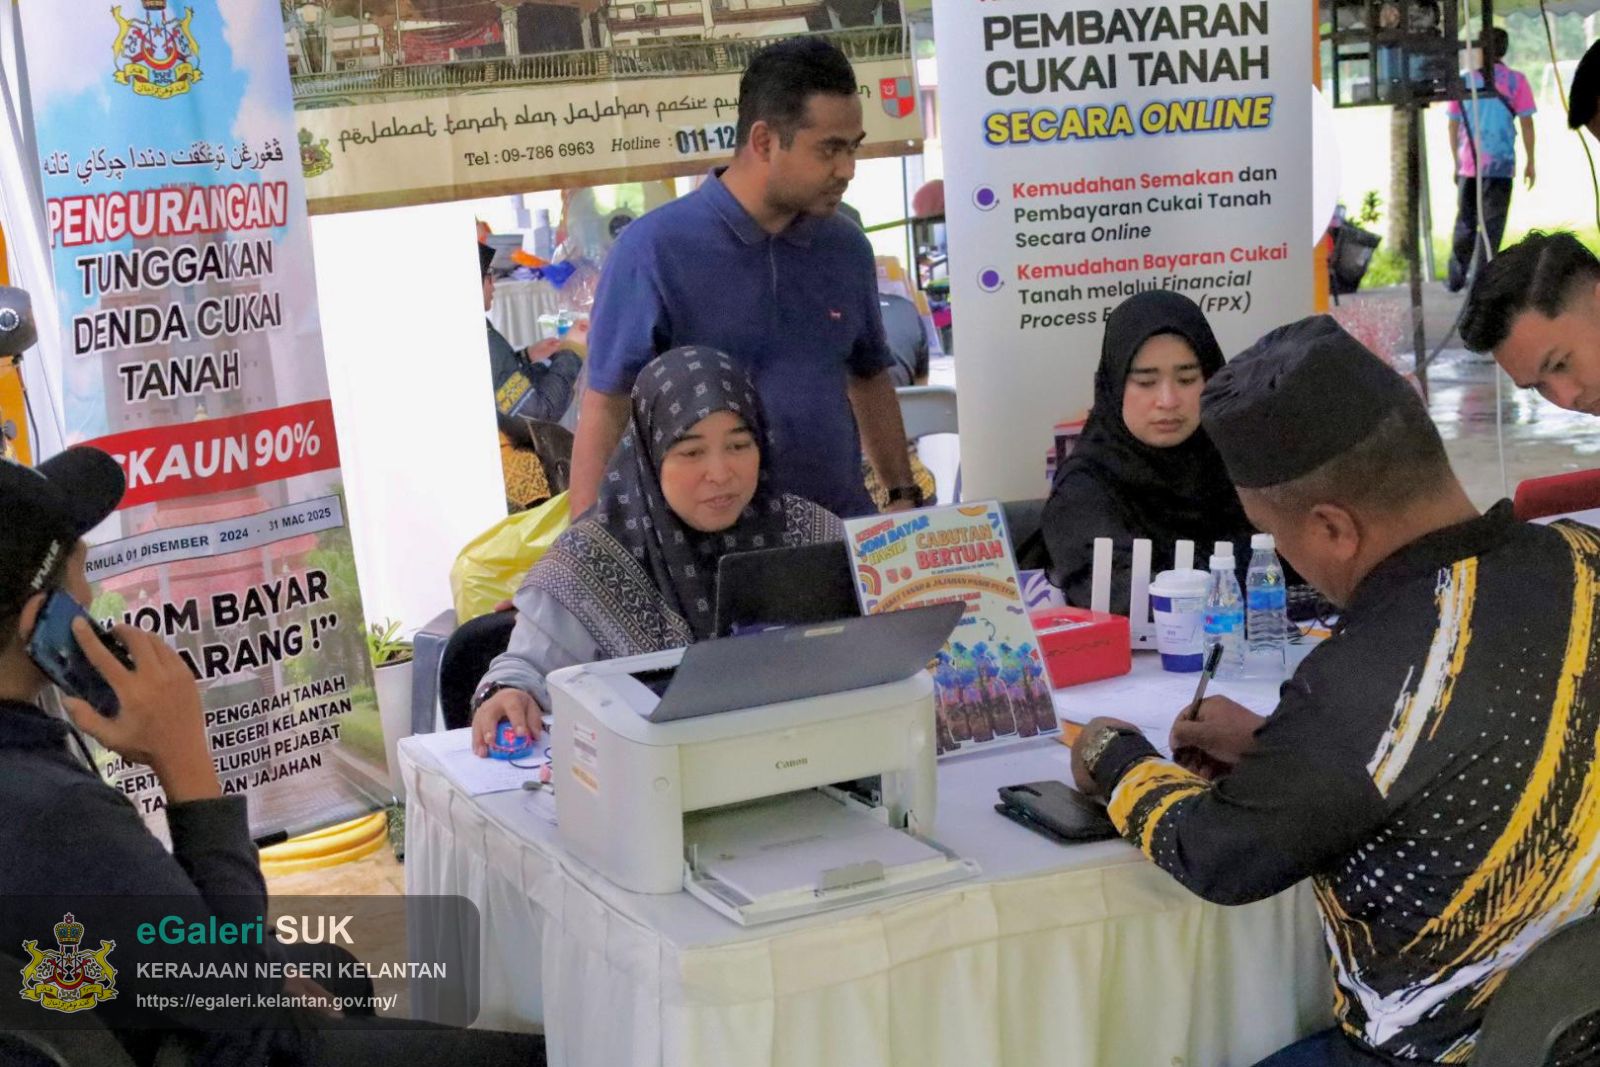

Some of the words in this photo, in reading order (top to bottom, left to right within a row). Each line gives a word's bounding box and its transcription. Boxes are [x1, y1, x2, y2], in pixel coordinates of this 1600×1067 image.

[983, 1, 1269, 51] PEMBAYARAN
[986, 53, 1118, 96] CUKAI
[1128, 45, 1270, 86] TANAH
[985, 104, 1135, 145] SECARA
[1141, 95, 1273, 133] ONLINE
[464, 151, 490, 166] Tel
[501, 145, 554, 163] 09-786
[558, 141, 595, 158] 6963
[611, 135, 661, 153] Hotline
[675, 126, 736, 154] 011-12
[1013, 176, 1136, 199] Kemudahan
[1140, 168, 1234, 190] Semakan
[1238, 166, 1277, 183] dan
[1014, 199, 1143, 223] Pembayaran
[1147, 193, 1203, 213] Cukai
[1209, 190, 1272, 209] Tanah
[48, 182, 288, 247] PENGURANGAN
[1015, 230, 1086, 248] Secara
[1091, 223, 1152, 243] Online
[78, 240, 273, 295] TUNGGAKAN
[1017, 257, 1139, 281] Kemudahan
[1144, 250, 1226, 272] Bayaran
[1230, 243, 1288, 263] Cukai
[1018, 285, 1083, 305] Tanah
[1088, 278, 1157, 300] melalui
[1162, 271, 1252, 291] Financial
[1020, 309, 1097, 330] Process
[1200, 291, 1252, 314] (FPX)
[74, 304, 188, 355] DENDA
[198, 292, 282, 337] CUKAI
[120, 352, 240, 401] TANAH
[112, 433, 248, 489] KAUN
[254, 419, 321, 467] 90%
[85, 553, 124, 573] RMULA
[126, 549, 137, 562] 01
[141, 535, 209, 556] DISEMBER
[219, 528, 249, 543] 2024
[268, 519, 278, 531] 31
[282, 514, 305, 528] MAC
[307, 507, 332, 523] 2025
[888, 515, 931, 543] BAYAR
[915, 524, 993, 550] CABUTAN
[915, 540, 1004, 570] BERTUAH
[213, 569, 329, 628] BAYAR
[178, 624, 303, 680] RANG
[205, 691, 291, 728] PENGARAH
[293, 676, 346, 703] TANAH
[212, 721, 269, 750] NEGERI
[272, 698, 352, 733] KELANTAN
[115, 773, 161, 794] SERT
[213, 745, 271, 774] ELURUH
[274, 724, 341, 756] PEJABAT
[223, 776, 248, 795] AN
[252, 753, 322, 787] JAJAHAN
[775, 757, 808, 769] Canon
